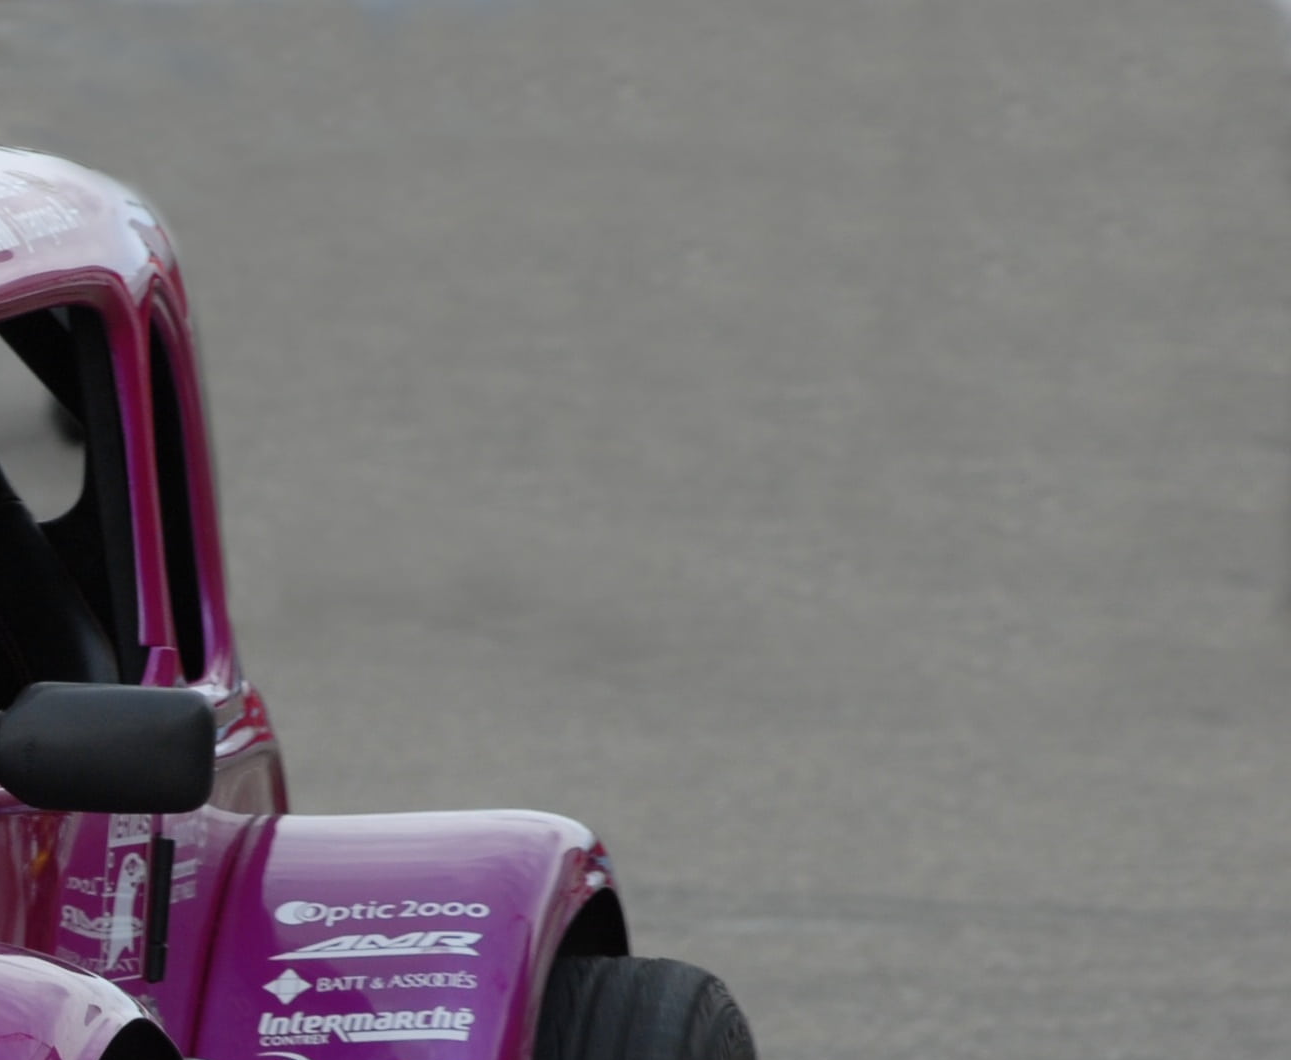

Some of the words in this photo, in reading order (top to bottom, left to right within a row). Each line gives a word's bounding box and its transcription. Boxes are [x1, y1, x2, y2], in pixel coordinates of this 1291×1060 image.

[280, 900, 397, 927] Optic
[398, 899, 491, 918] 2000
[315, 975, 368, 993] BATT
[369, 976, 385, 990] &
[257, 1006, 476, 1041] Intermarché
